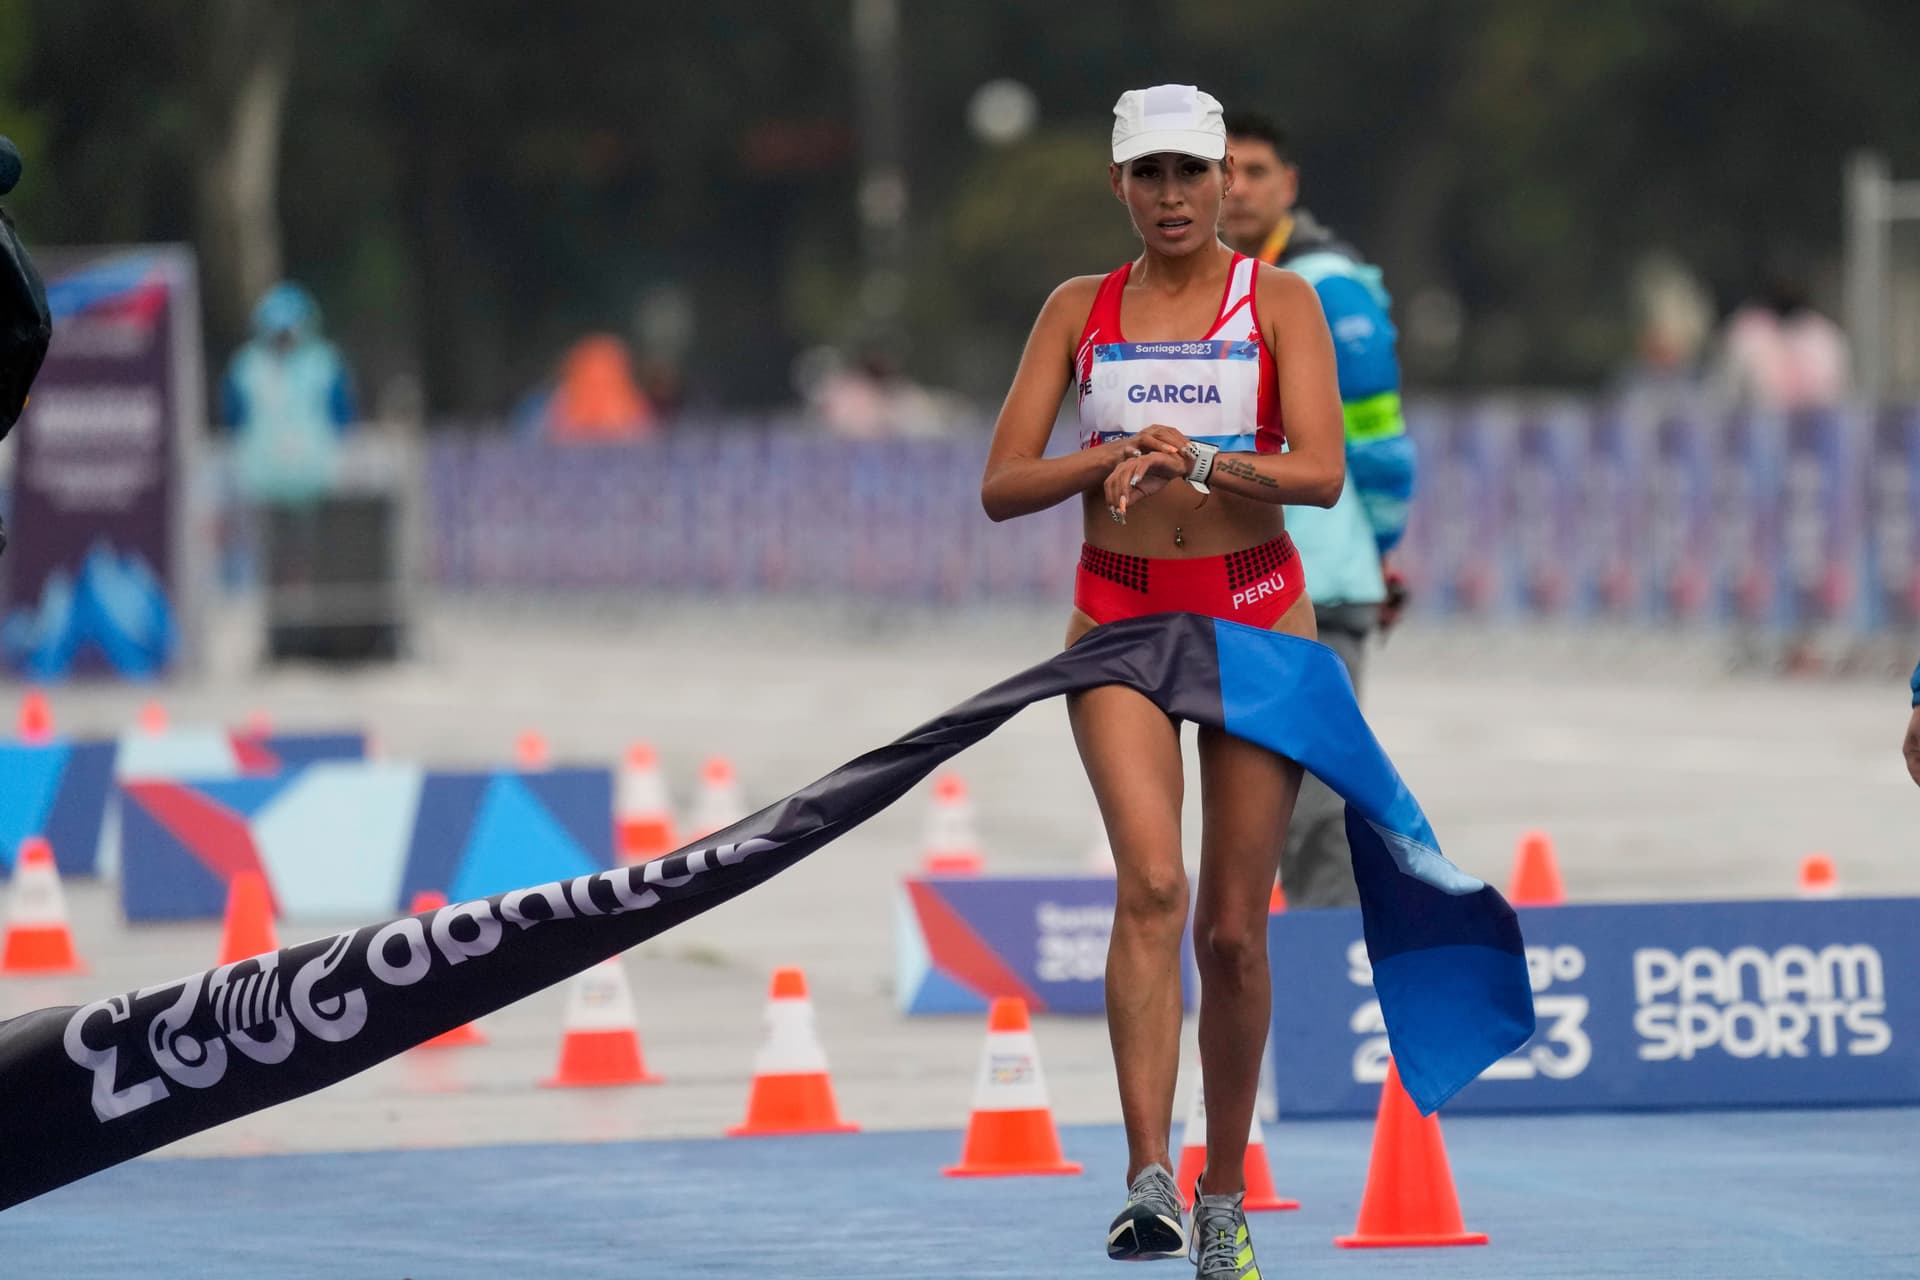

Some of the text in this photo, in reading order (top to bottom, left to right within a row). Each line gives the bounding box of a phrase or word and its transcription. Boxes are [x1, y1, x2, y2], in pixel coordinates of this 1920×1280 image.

[1128, 384, 1222, 404] GARCIA
[1232, 573, 1286, 610] PERÚ
[1633, 944, 1885, 1004] PANAM
[1633, 1001, 1893, 1060] SPORTS
